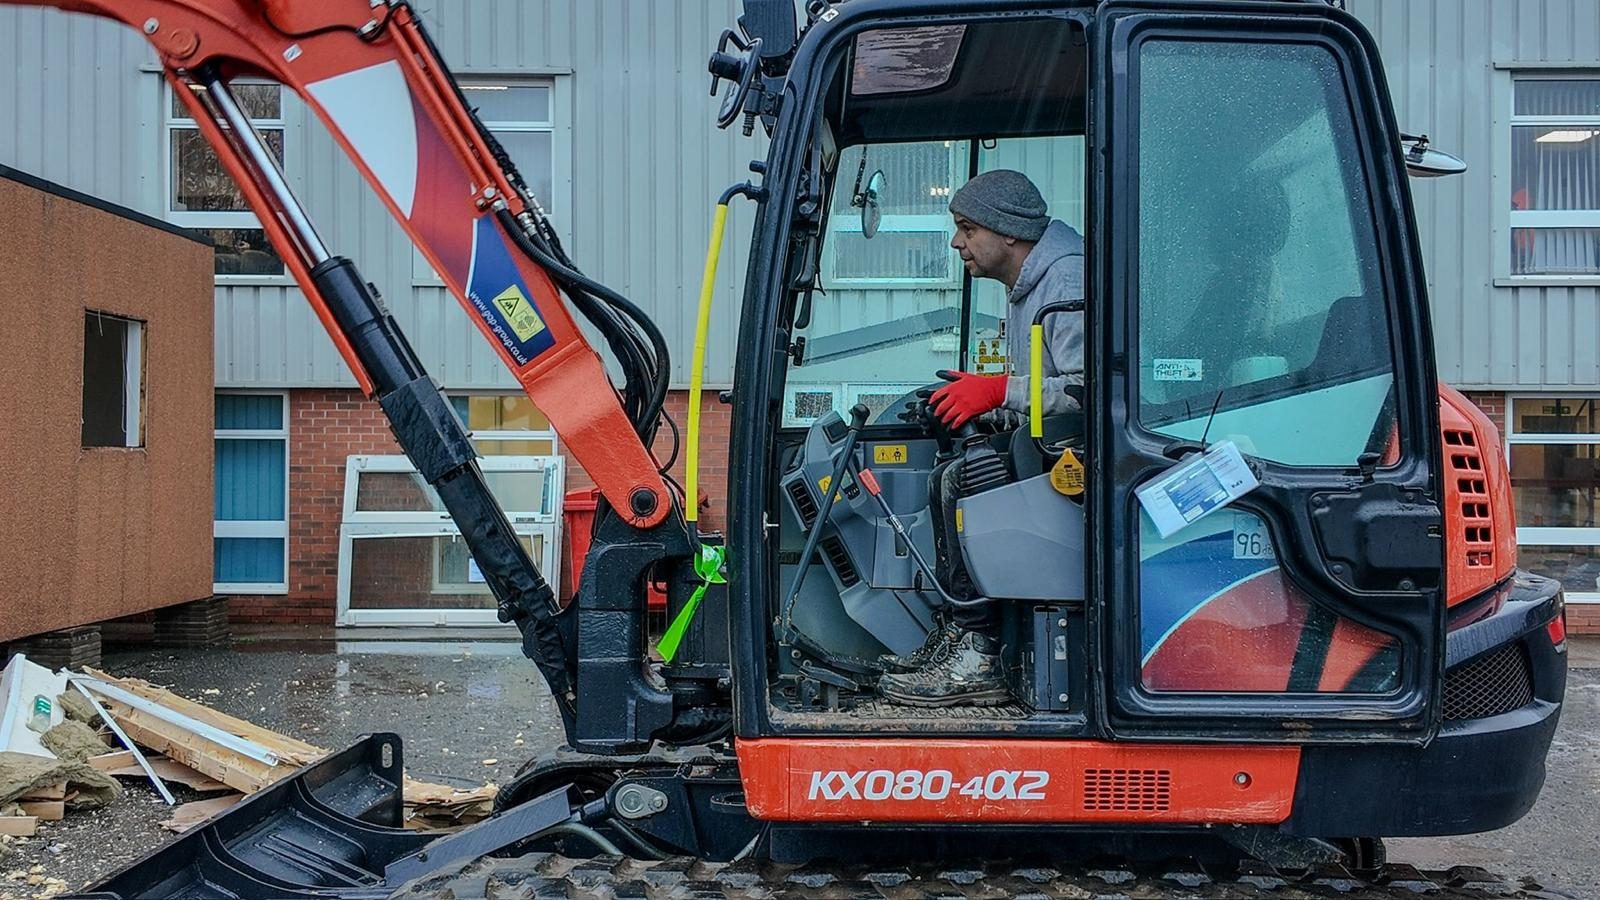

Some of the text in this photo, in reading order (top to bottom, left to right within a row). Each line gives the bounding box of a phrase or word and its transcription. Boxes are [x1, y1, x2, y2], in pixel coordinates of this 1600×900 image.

[469, 291, 528, 366] www.gap-group.co.uk
[1155, 369, 1183, 377] THEFT
[1236, 532, 1262, 556] 96
